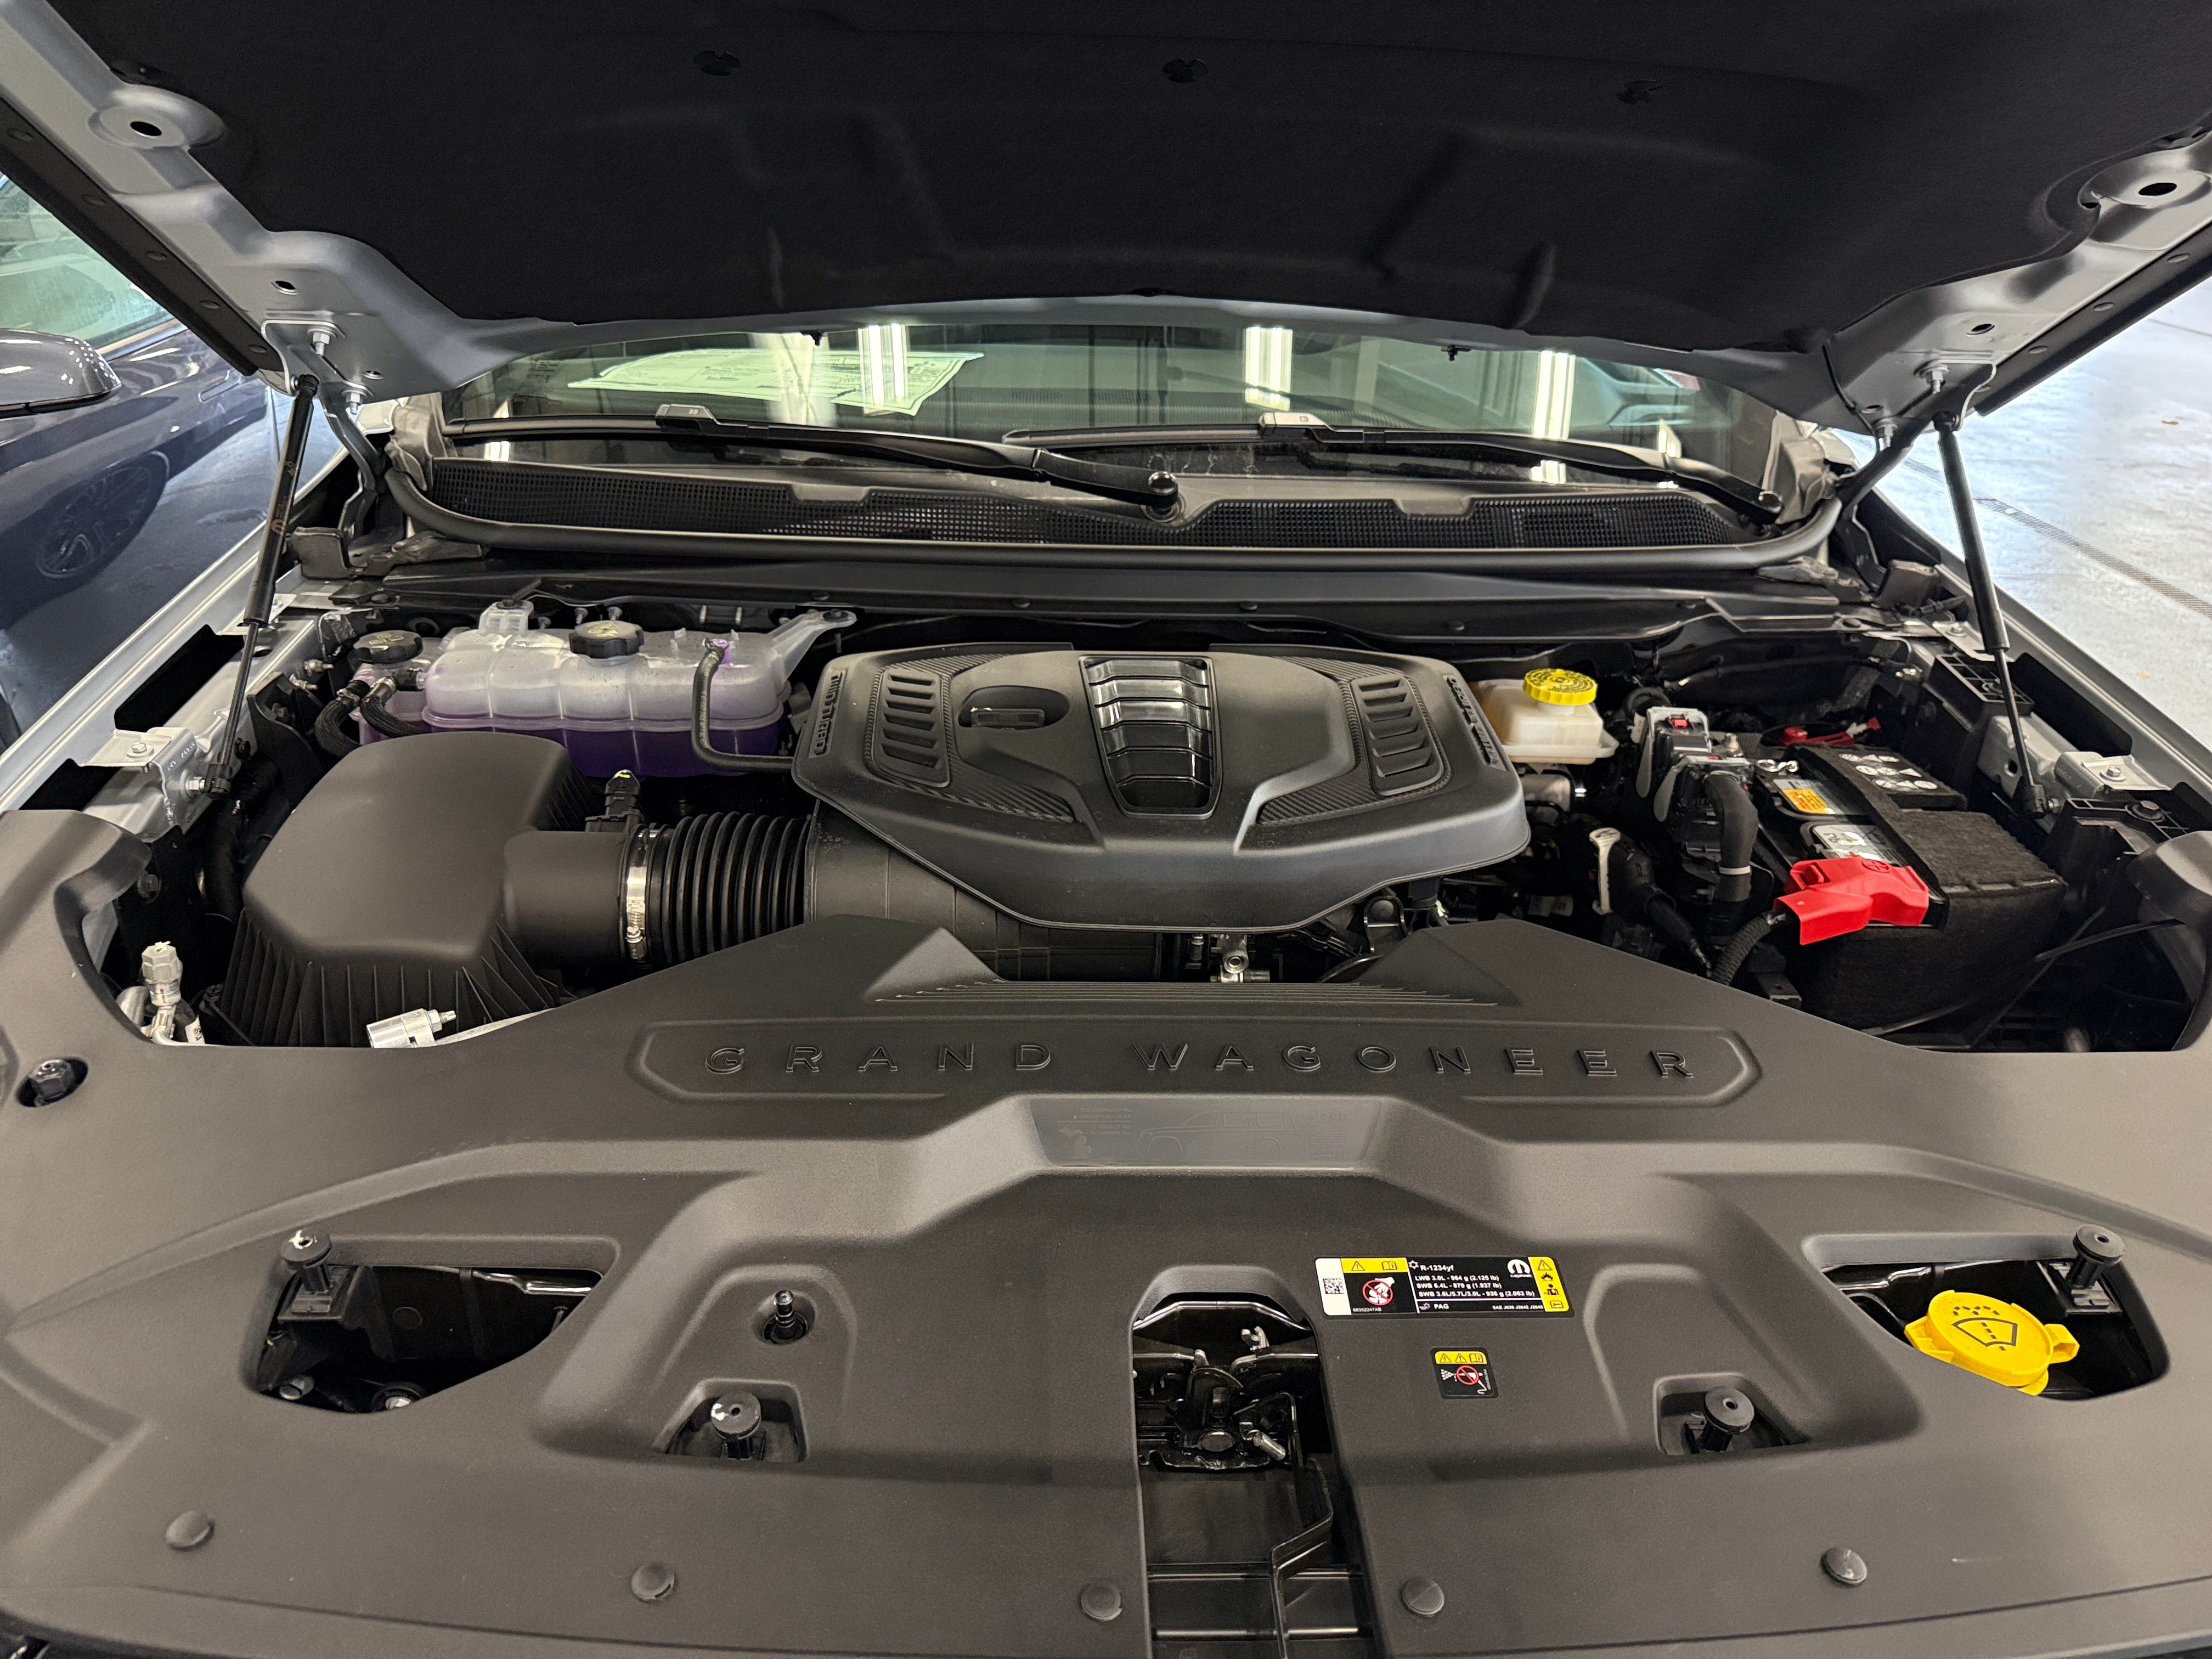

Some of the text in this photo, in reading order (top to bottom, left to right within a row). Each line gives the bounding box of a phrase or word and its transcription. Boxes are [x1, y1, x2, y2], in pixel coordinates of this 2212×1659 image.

[815, 706, 835, 756] TURBO
[705, 1042, 1694, 1078] GRAND WAGONEER
